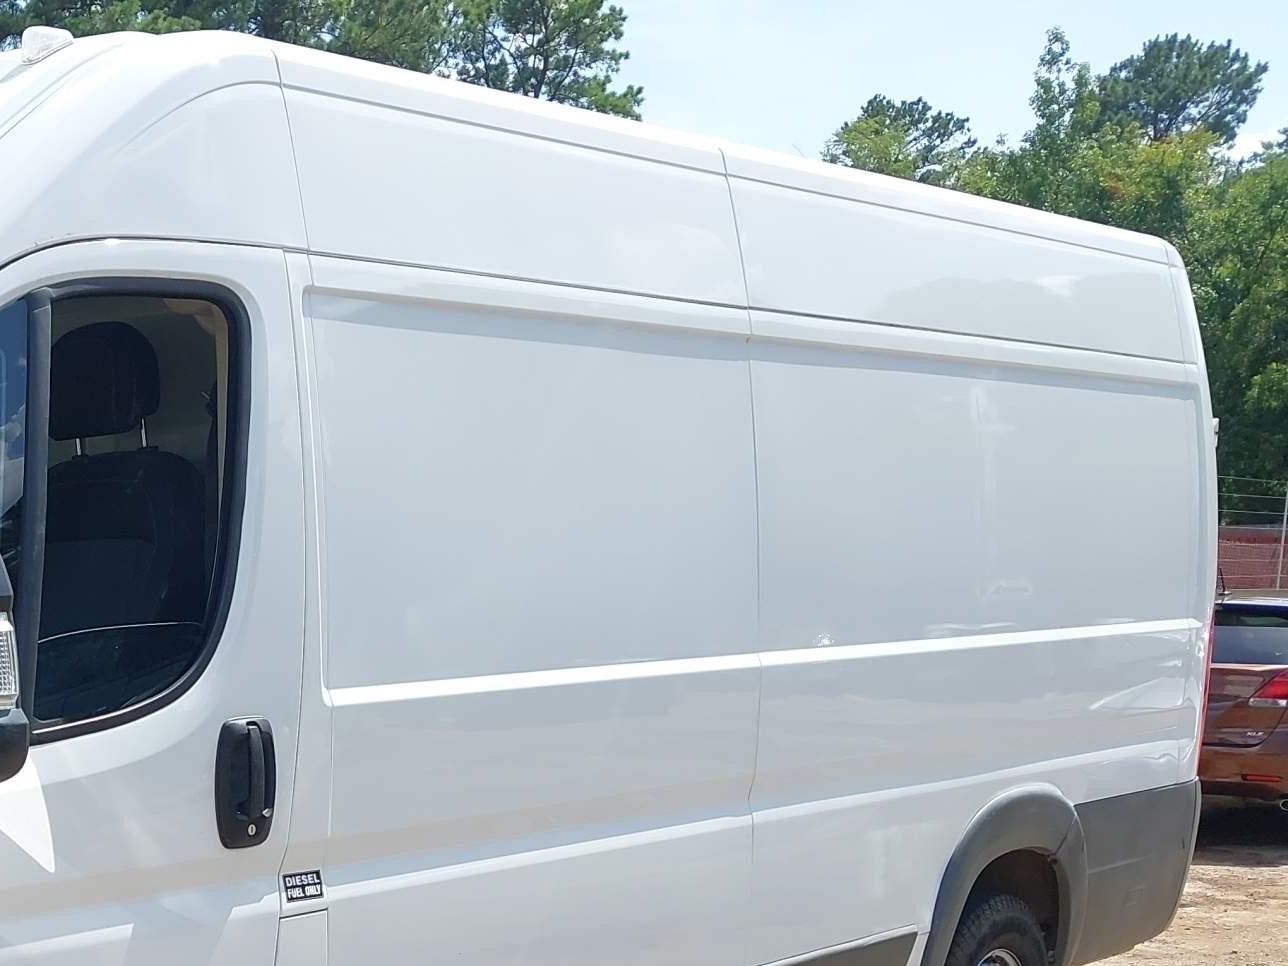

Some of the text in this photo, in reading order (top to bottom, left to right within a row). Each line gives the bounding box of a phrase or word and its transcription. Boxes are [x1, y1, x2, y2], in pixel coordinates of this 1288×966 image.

[285, 873, 320, 886] DIESEL
[287, 884, 321, 898] FUEL ONLY
